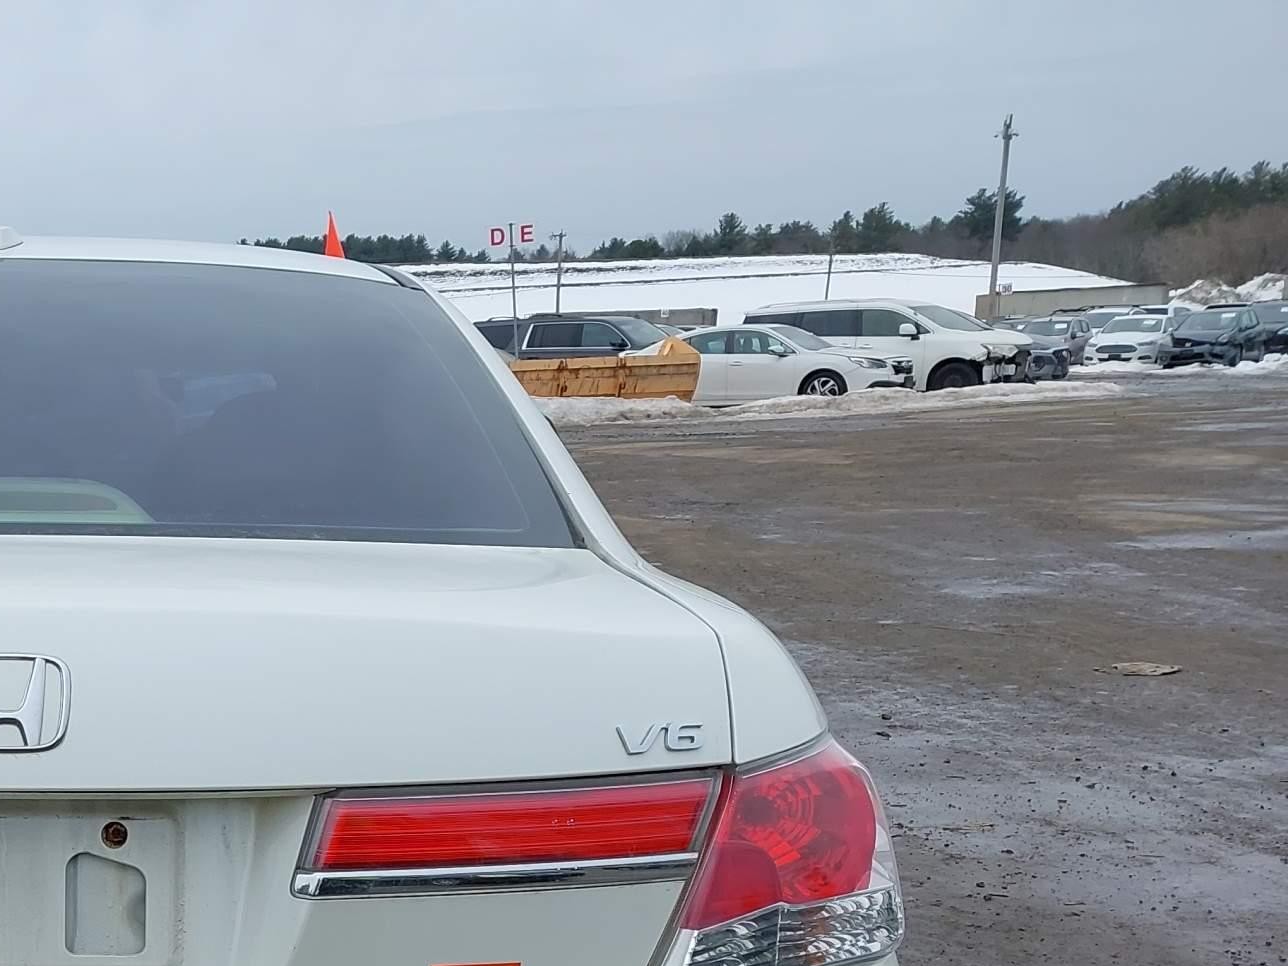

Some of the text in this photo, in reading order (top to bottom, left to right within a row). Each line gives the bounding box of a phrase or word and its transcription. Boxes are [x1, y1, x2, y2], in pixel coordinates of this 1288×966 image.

[490, 228, 505, 246] D
[520, 224, 534, 243] E
[615, 722, 703, 756] V6
